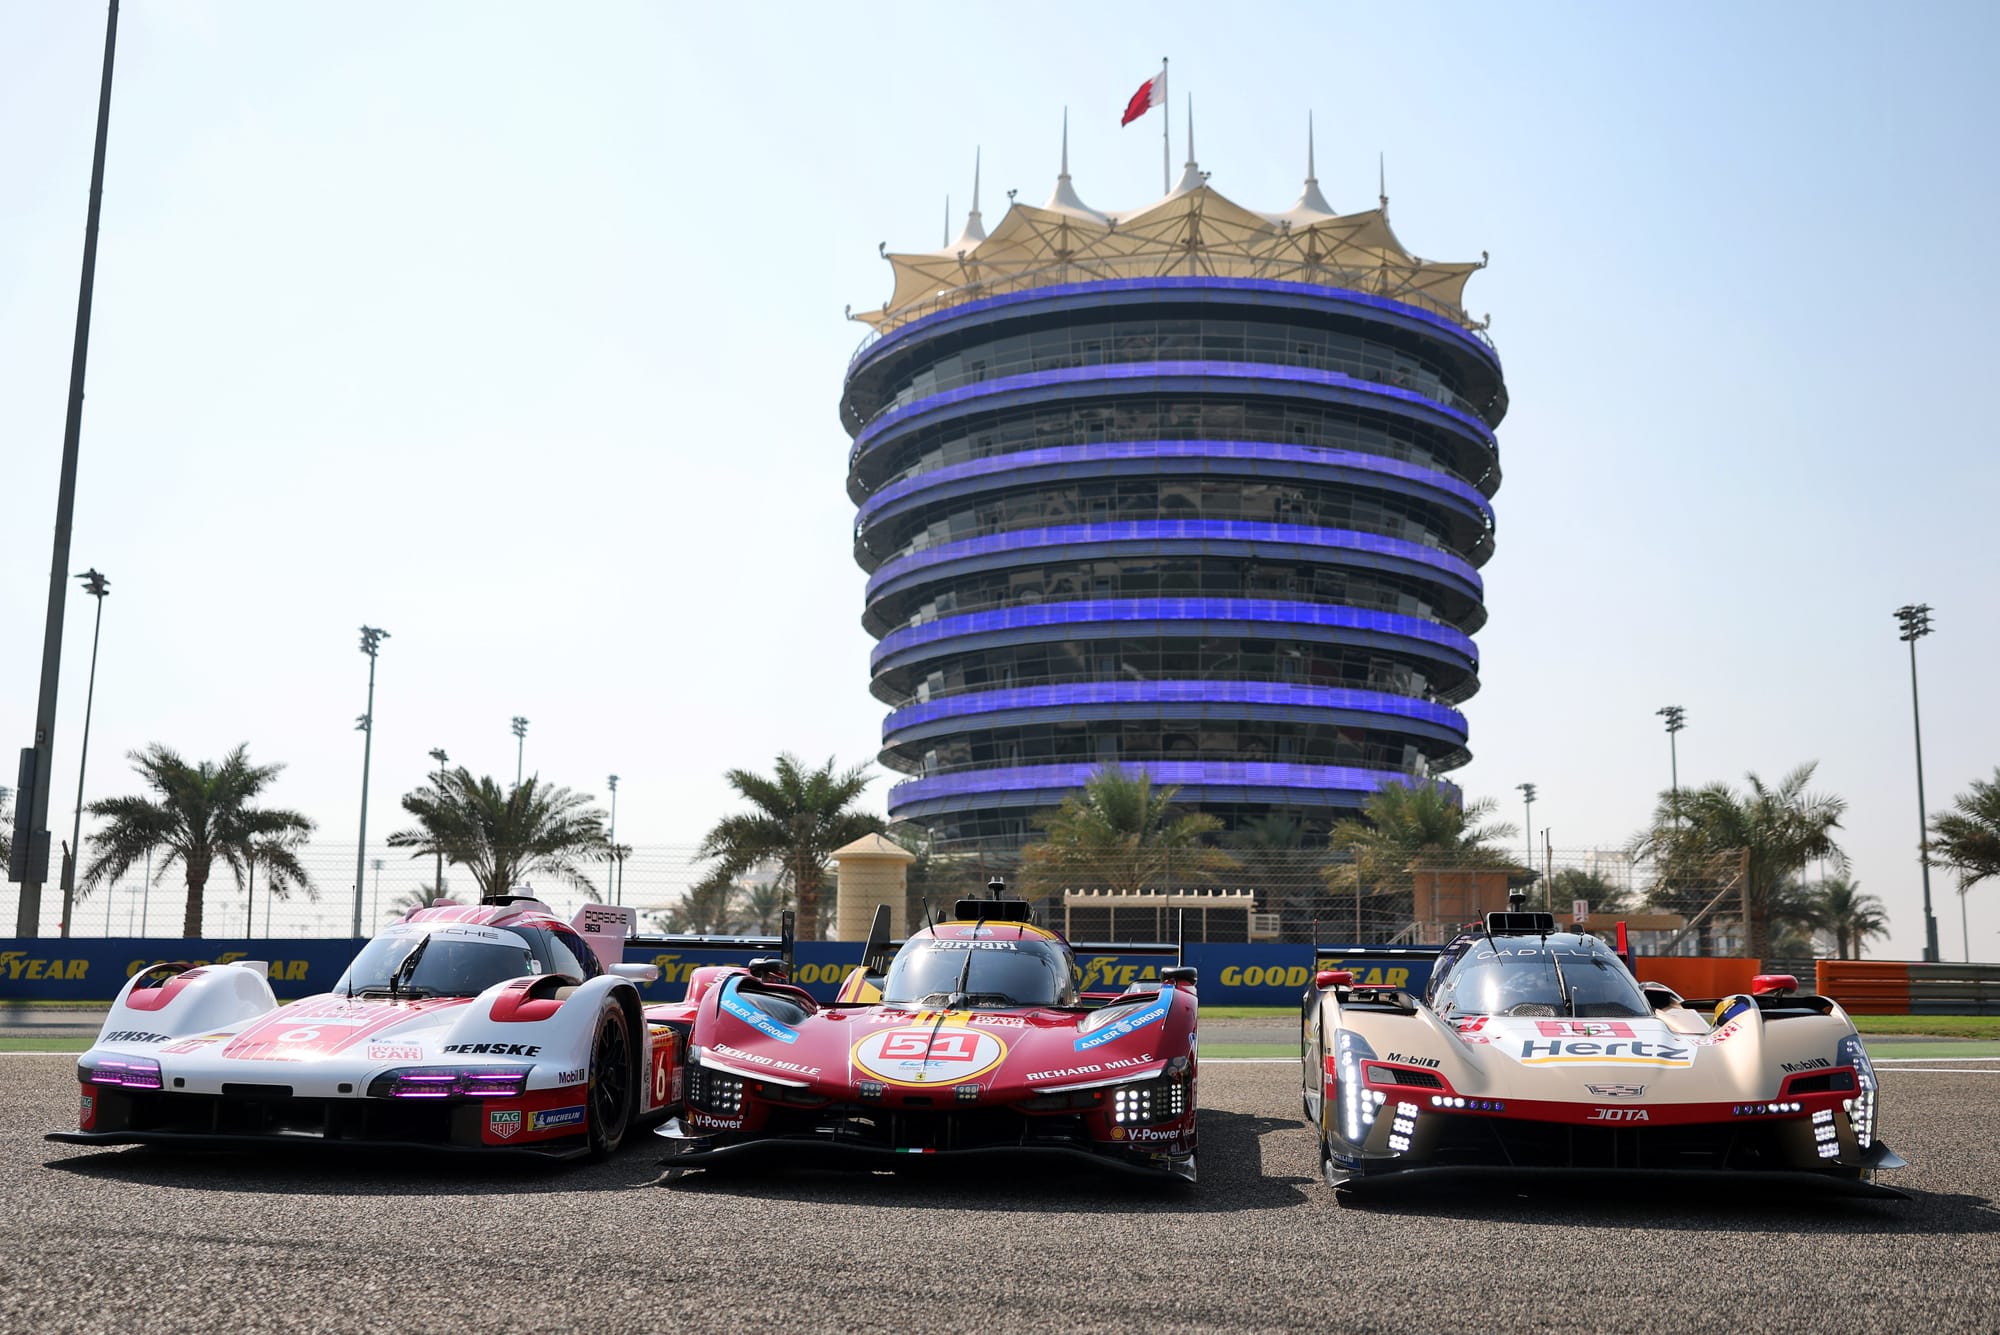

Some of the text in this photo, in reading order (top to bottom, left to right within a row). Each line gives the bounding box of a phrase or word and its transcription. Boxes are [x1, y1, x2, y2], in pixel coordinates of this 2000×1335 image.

[584, 910, 627, 924] PORSCHE
[584, 924, 601, 933] 963
[929, 939, 1019, 951] Ferrari
[721, 998, 793, 1041] ADLER GROUP
[278, 1024, 324, 1042] 6
[1081, 1007, 1166, 1050] ADLER GROUP
[103, 1030, 172, 1044] PENSKE
[442, 1042, 543, 1058] PENSKE
[885, 1034, 970, 1057] 51
[1521, 1039, 1689, 1060] Hertz
[371, 1050, 419, 1060] CAR
[712, 1043, 822, 1075] RICHARD MILLE
[1387, 1052, 1428, 1067] Mobil
[1026, 1053, 1154, 1081] RICHARD MILLE
[1781, 1059, 1818, 1073] Mobil
[558, 1069, 579, 1084] Mobil
[655, 1051, 666, 1101] 6
[493, 1112, 519, 1121] TAG
[546, 1111, 581, 1123] MICHELIN
[695, 1114, 743, 1129] V-Power
[1586, 1108, 1650, 1121] JOTA
[491, 1122, 520, 1136] HEUER
[1128, 1128, 1180, 1141] V-Power
